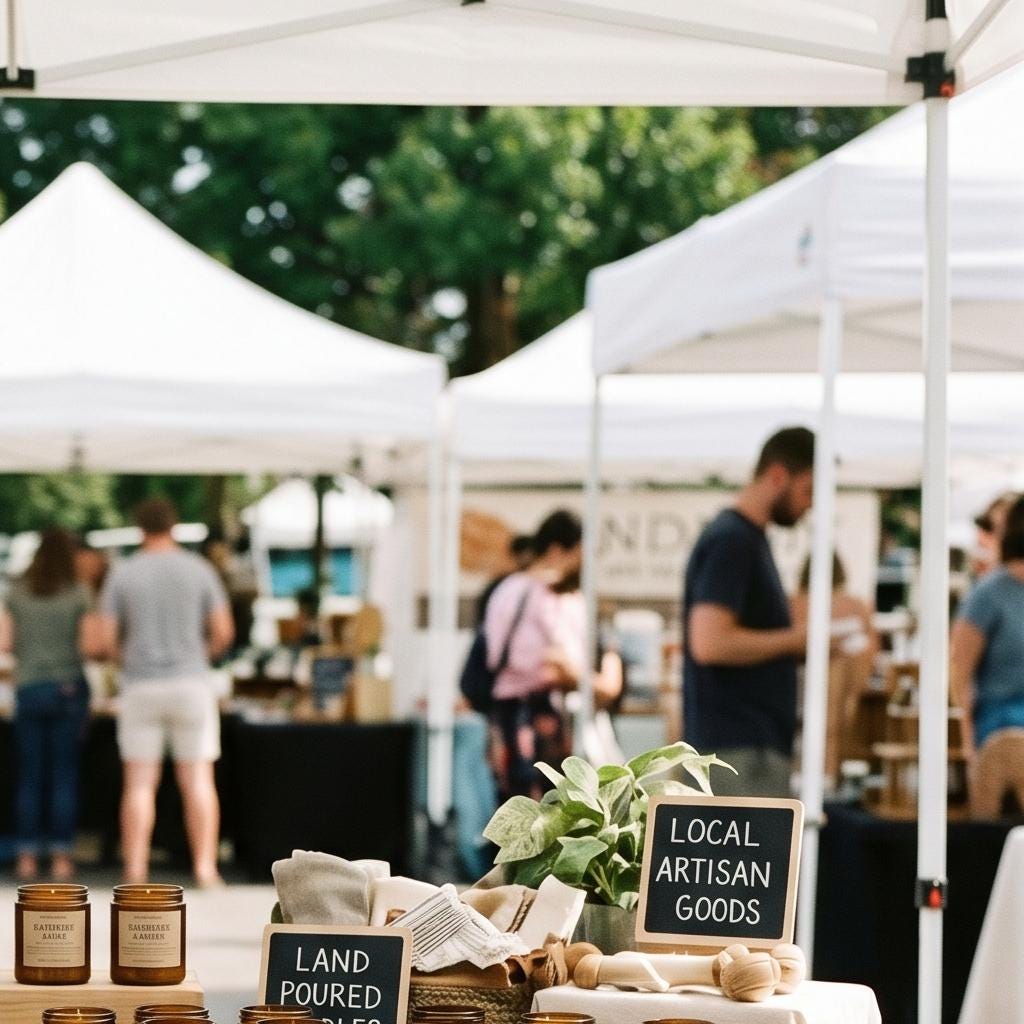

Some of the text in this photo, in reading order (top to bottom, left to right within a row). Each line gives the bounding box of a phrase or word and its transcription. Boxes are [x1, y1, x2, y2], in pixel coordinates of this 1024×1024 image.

[670, 817, 760, 847] LOCAL
[655, 856, 771, 888] ARTISAN
[676, 894, 761, 925] GOODS
[296, 946, 370, 973] LAND
[280, 980, 382, 1009] POURED
